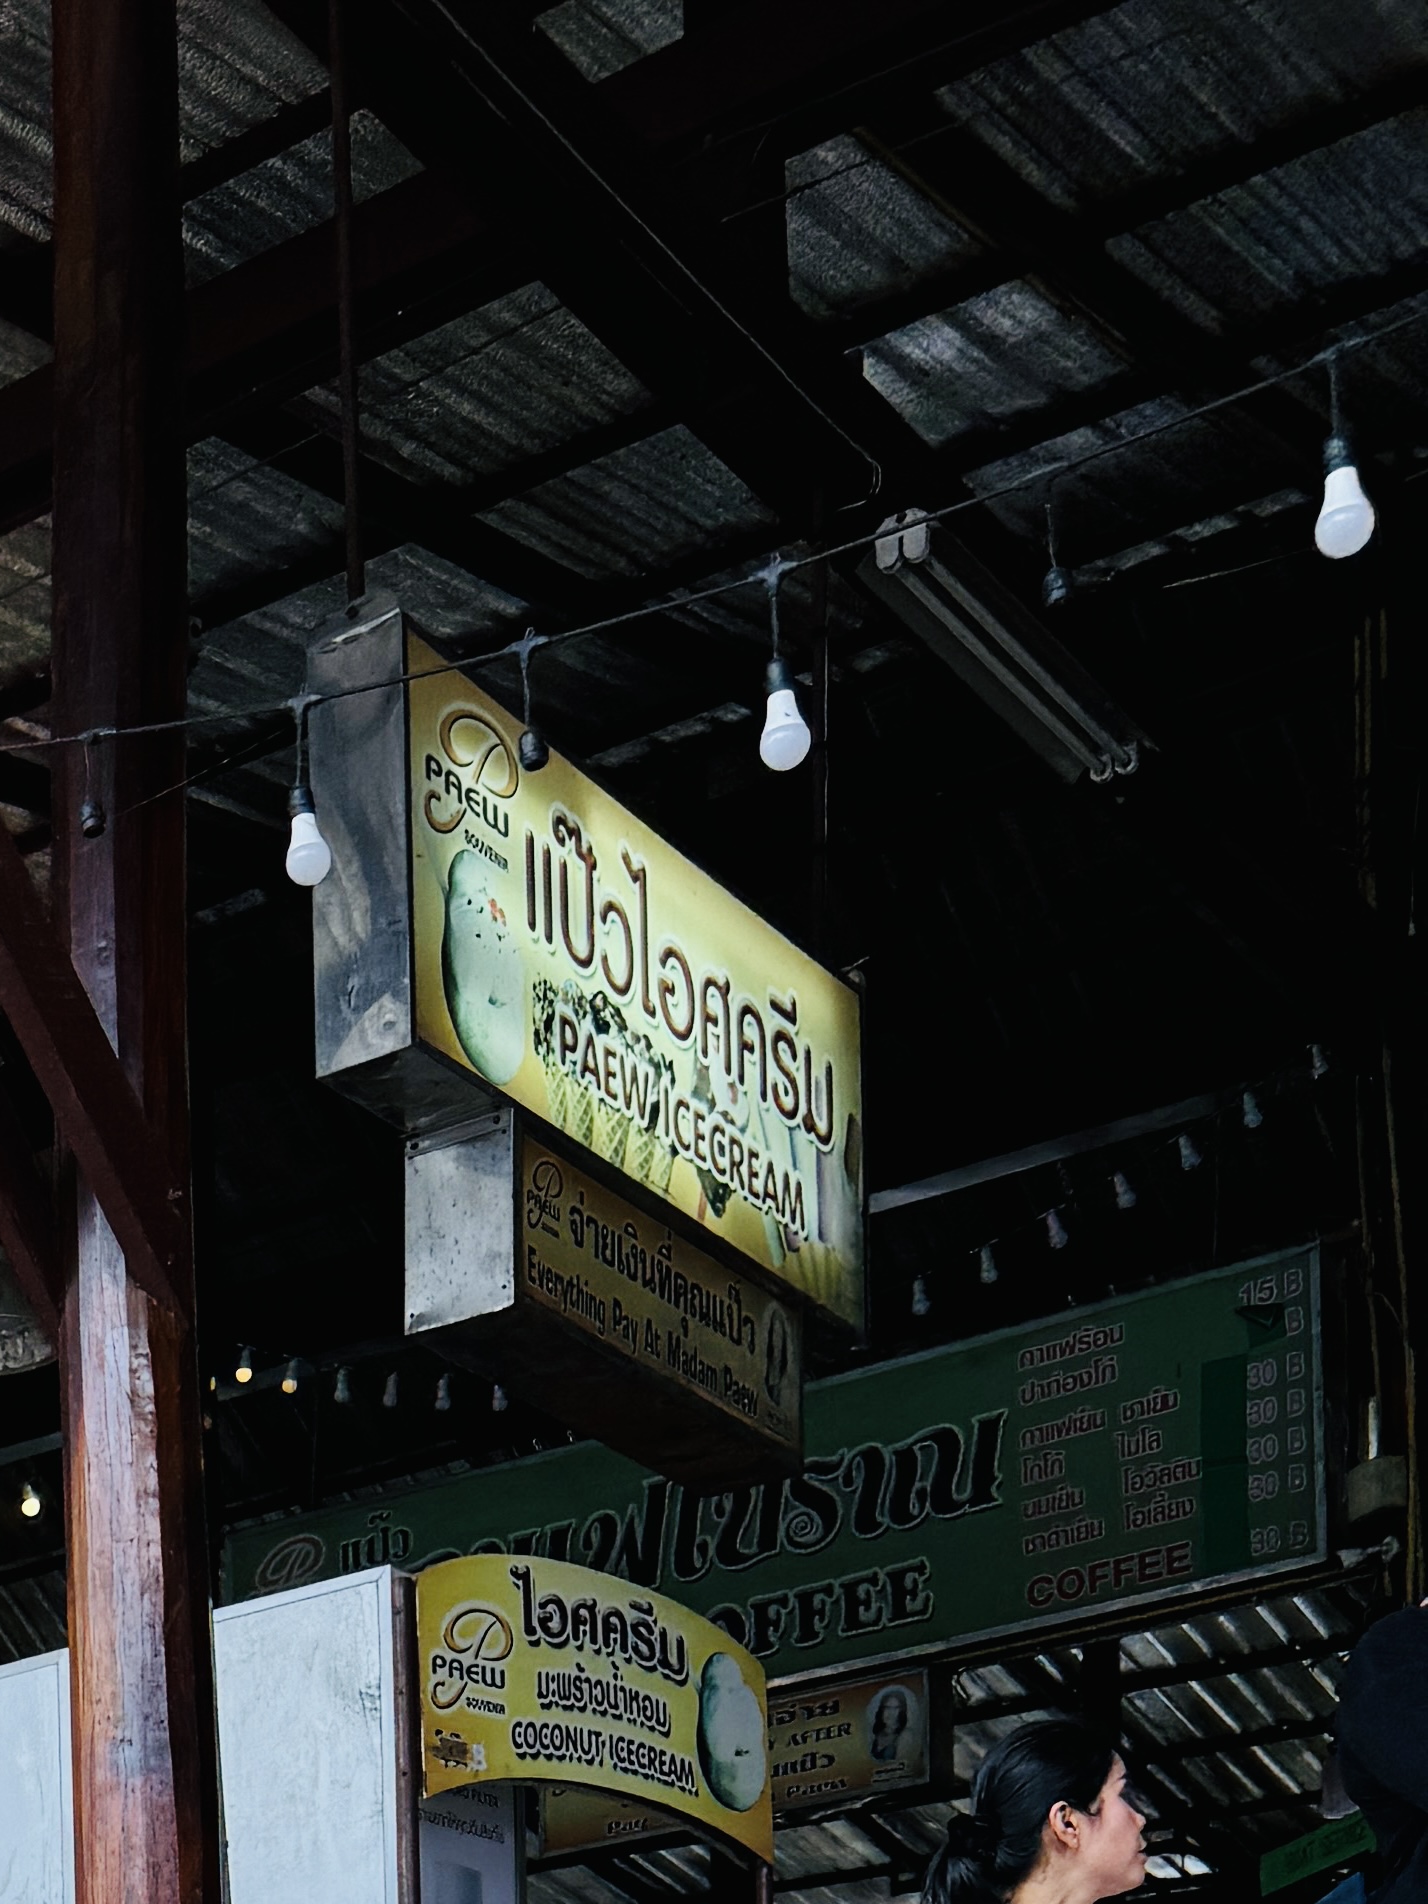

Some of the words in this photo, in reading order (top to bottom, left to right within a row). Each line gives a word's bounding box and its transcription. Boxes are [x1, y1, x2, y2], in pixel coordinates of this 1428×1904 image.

[425, 753, 510, 838] PAEW
[558, 1013, 652, 1131] PAEW
[659, 1070, 808, 1238] ICECREAM
[527, 1244, 606, 1338] Everything
[612, 1296, 639, 1355] Pay
[643, 1317, 661, 1360] At
[667, 1330, 718, 1390] Madam
[1025, 1540, 1193, 1609] COFFEE
[509, 1564, 688, 1684] ไอศครีม
[431, 1653, 506, 1690] PAEW
[511, 1719, 604, 1762] COCONUT
[608, 1732, 698, 1793] ICECREAM
